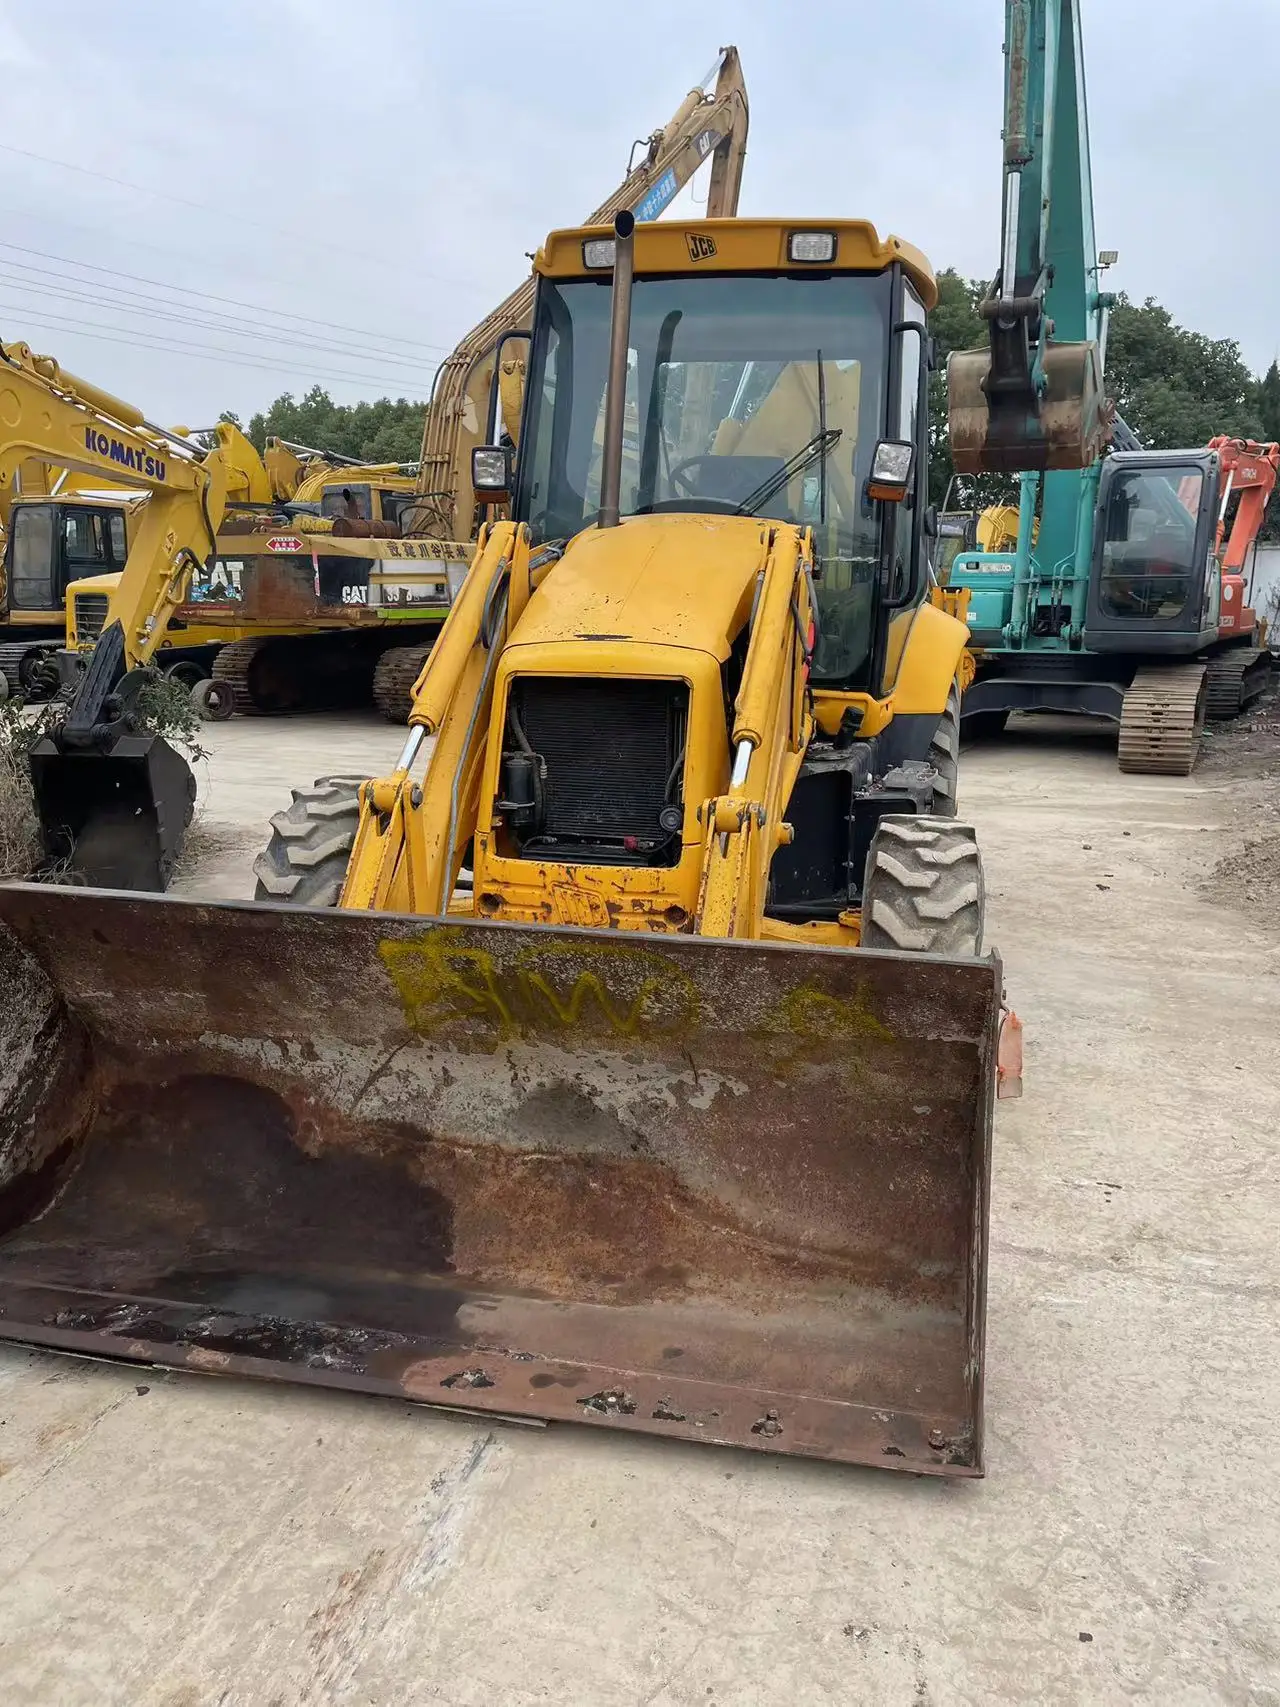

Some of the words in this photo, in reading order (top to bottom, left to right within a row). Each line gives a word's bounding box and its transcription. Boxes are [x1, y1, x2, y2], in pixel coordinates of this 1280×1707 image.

[690, 235, 715, 259] JCB
[85, 427, 166, 481] KOMATSU
[342, 585, 368, 604] CAT
